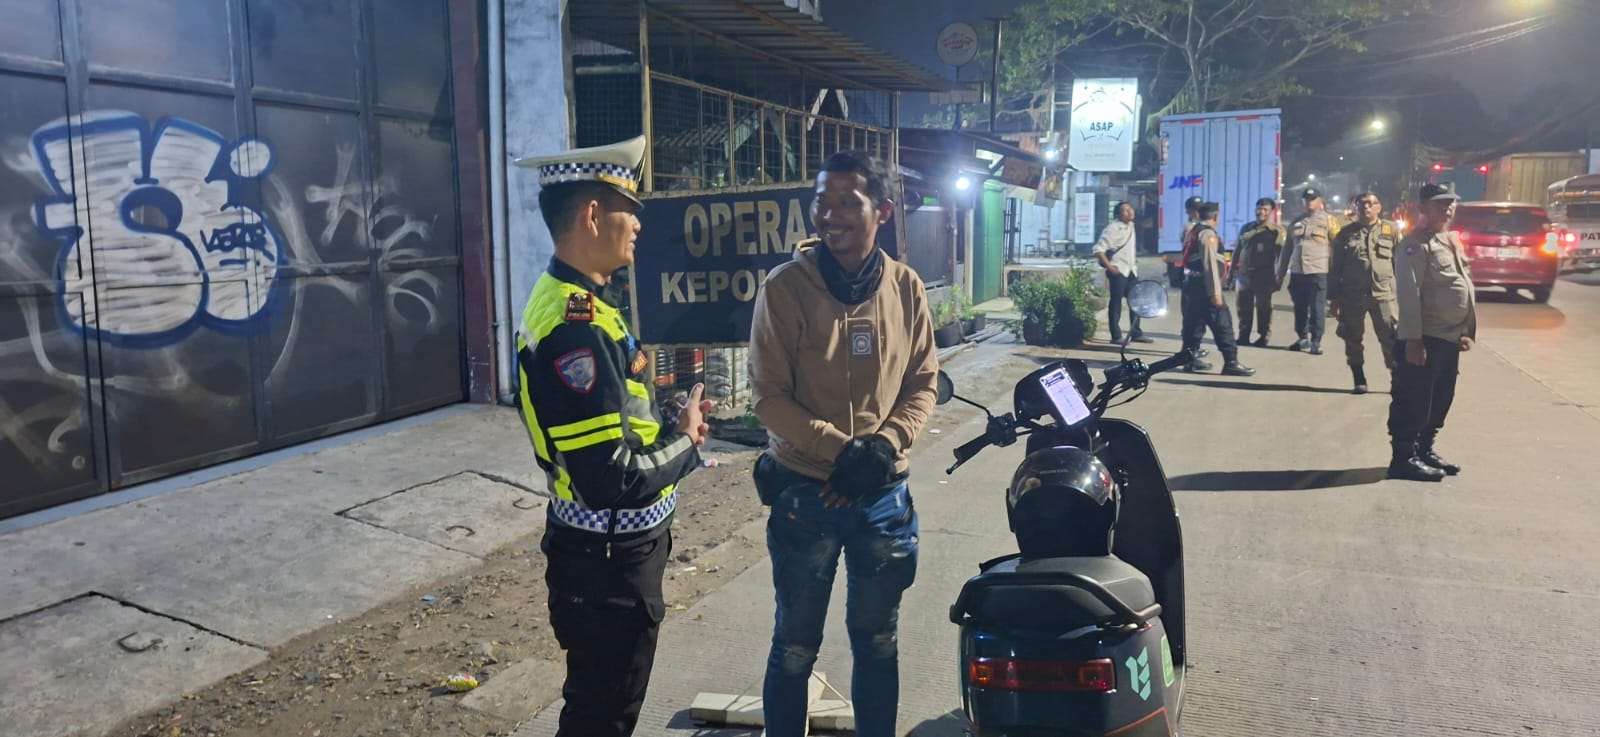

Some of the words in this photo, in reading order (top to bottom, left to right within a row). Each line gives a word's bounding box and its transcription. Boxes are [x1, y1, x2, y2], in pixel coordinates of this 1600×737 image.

[1090, 121, 1114, 131] ASAP
[1169, 175, 1204, 189] JNE
[684, 198, 818, 257] OPERA
